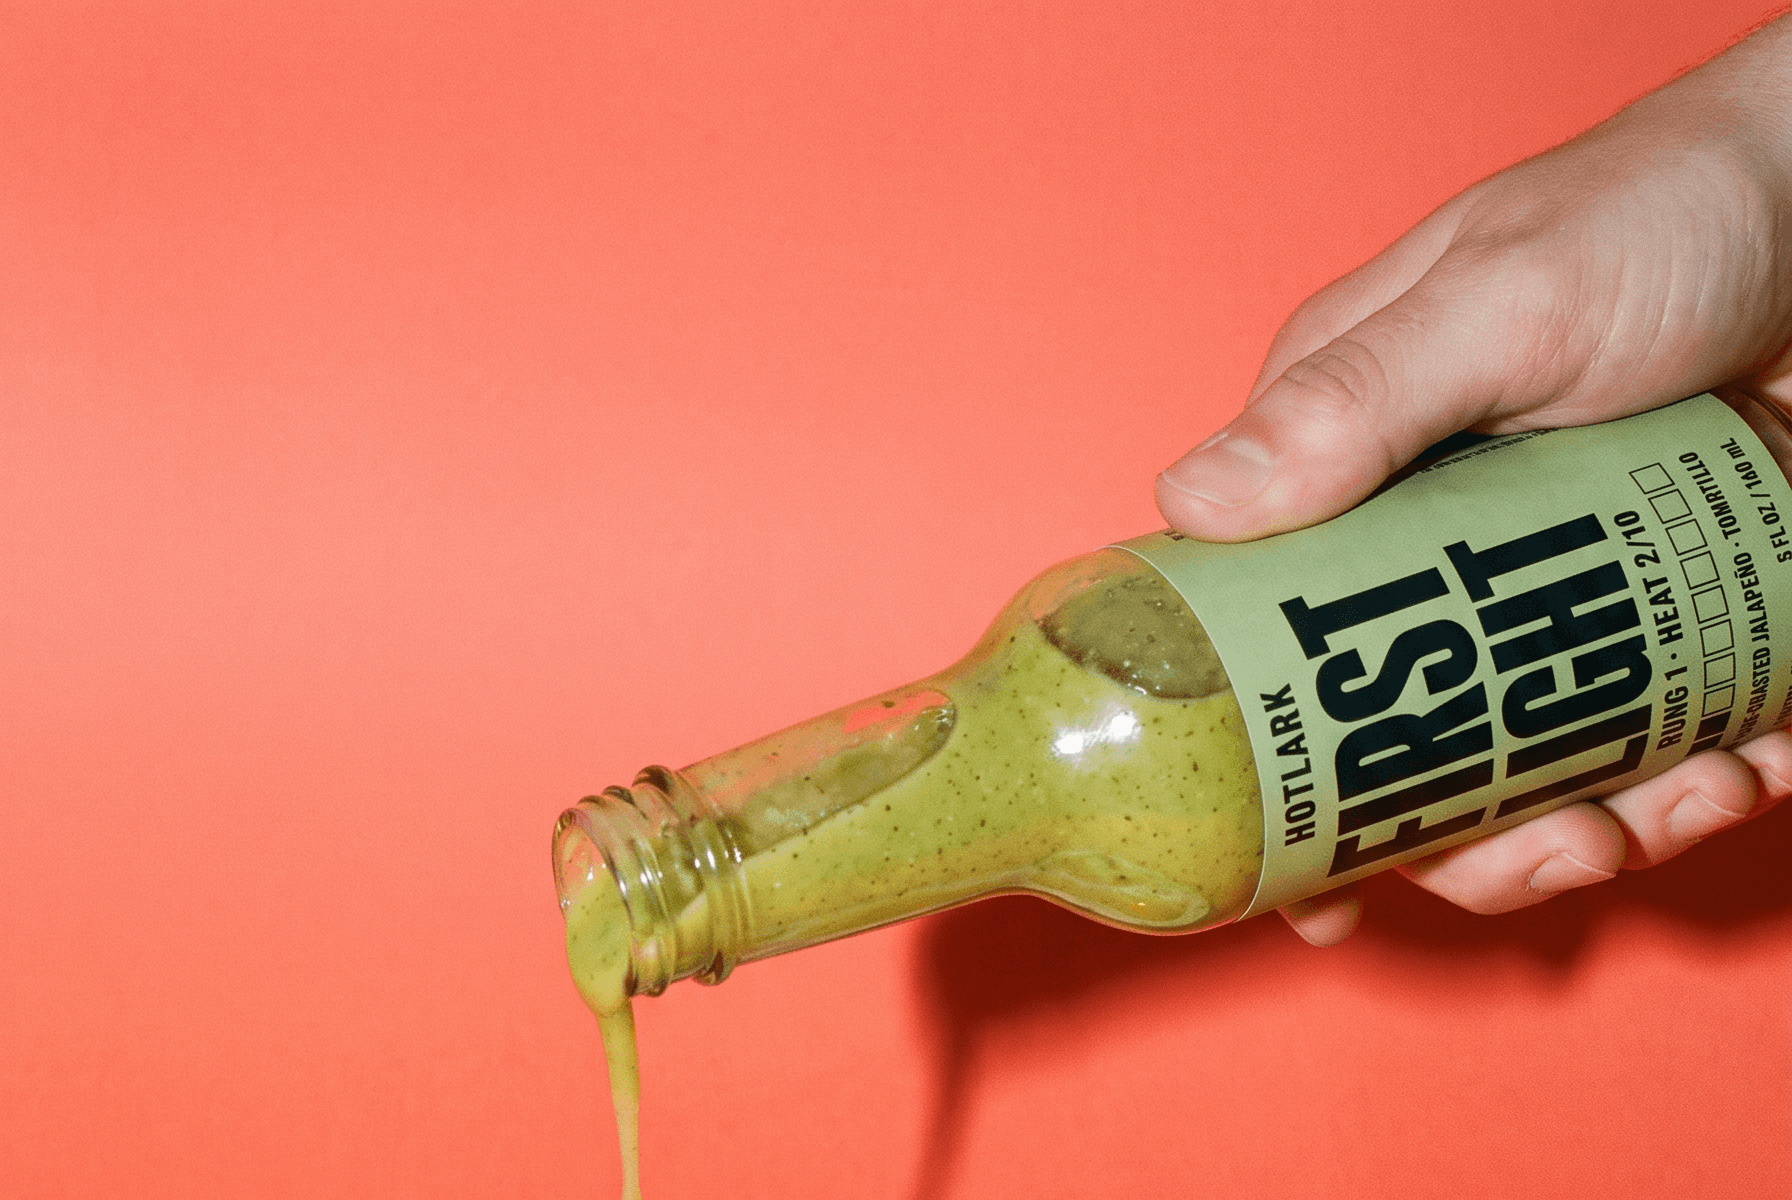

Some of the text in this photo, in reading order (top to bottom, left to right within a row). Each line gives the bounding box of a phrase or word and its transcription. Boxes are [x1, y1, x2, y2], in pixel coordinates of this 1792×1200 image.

[1720, 437, 1746, 459] mL
[1613, 510, 1661, 568] 2/10
[1757, 502, 1780, 525] OZ
[1769, 525, 1790, 549] FL
[1642, 576, 1684, 646] HEAT
[1733, 552, 1770, 642] JALAPEÑO
[1443, 513, 1652, 822] LIGHT
[1664, 666, 1688, 681] 1
[1279, 566, 1495, 878] FIRST
[1656, 686, 1689, 751] RUNG
[1260, 683, 1316, 847] HOTLARK
